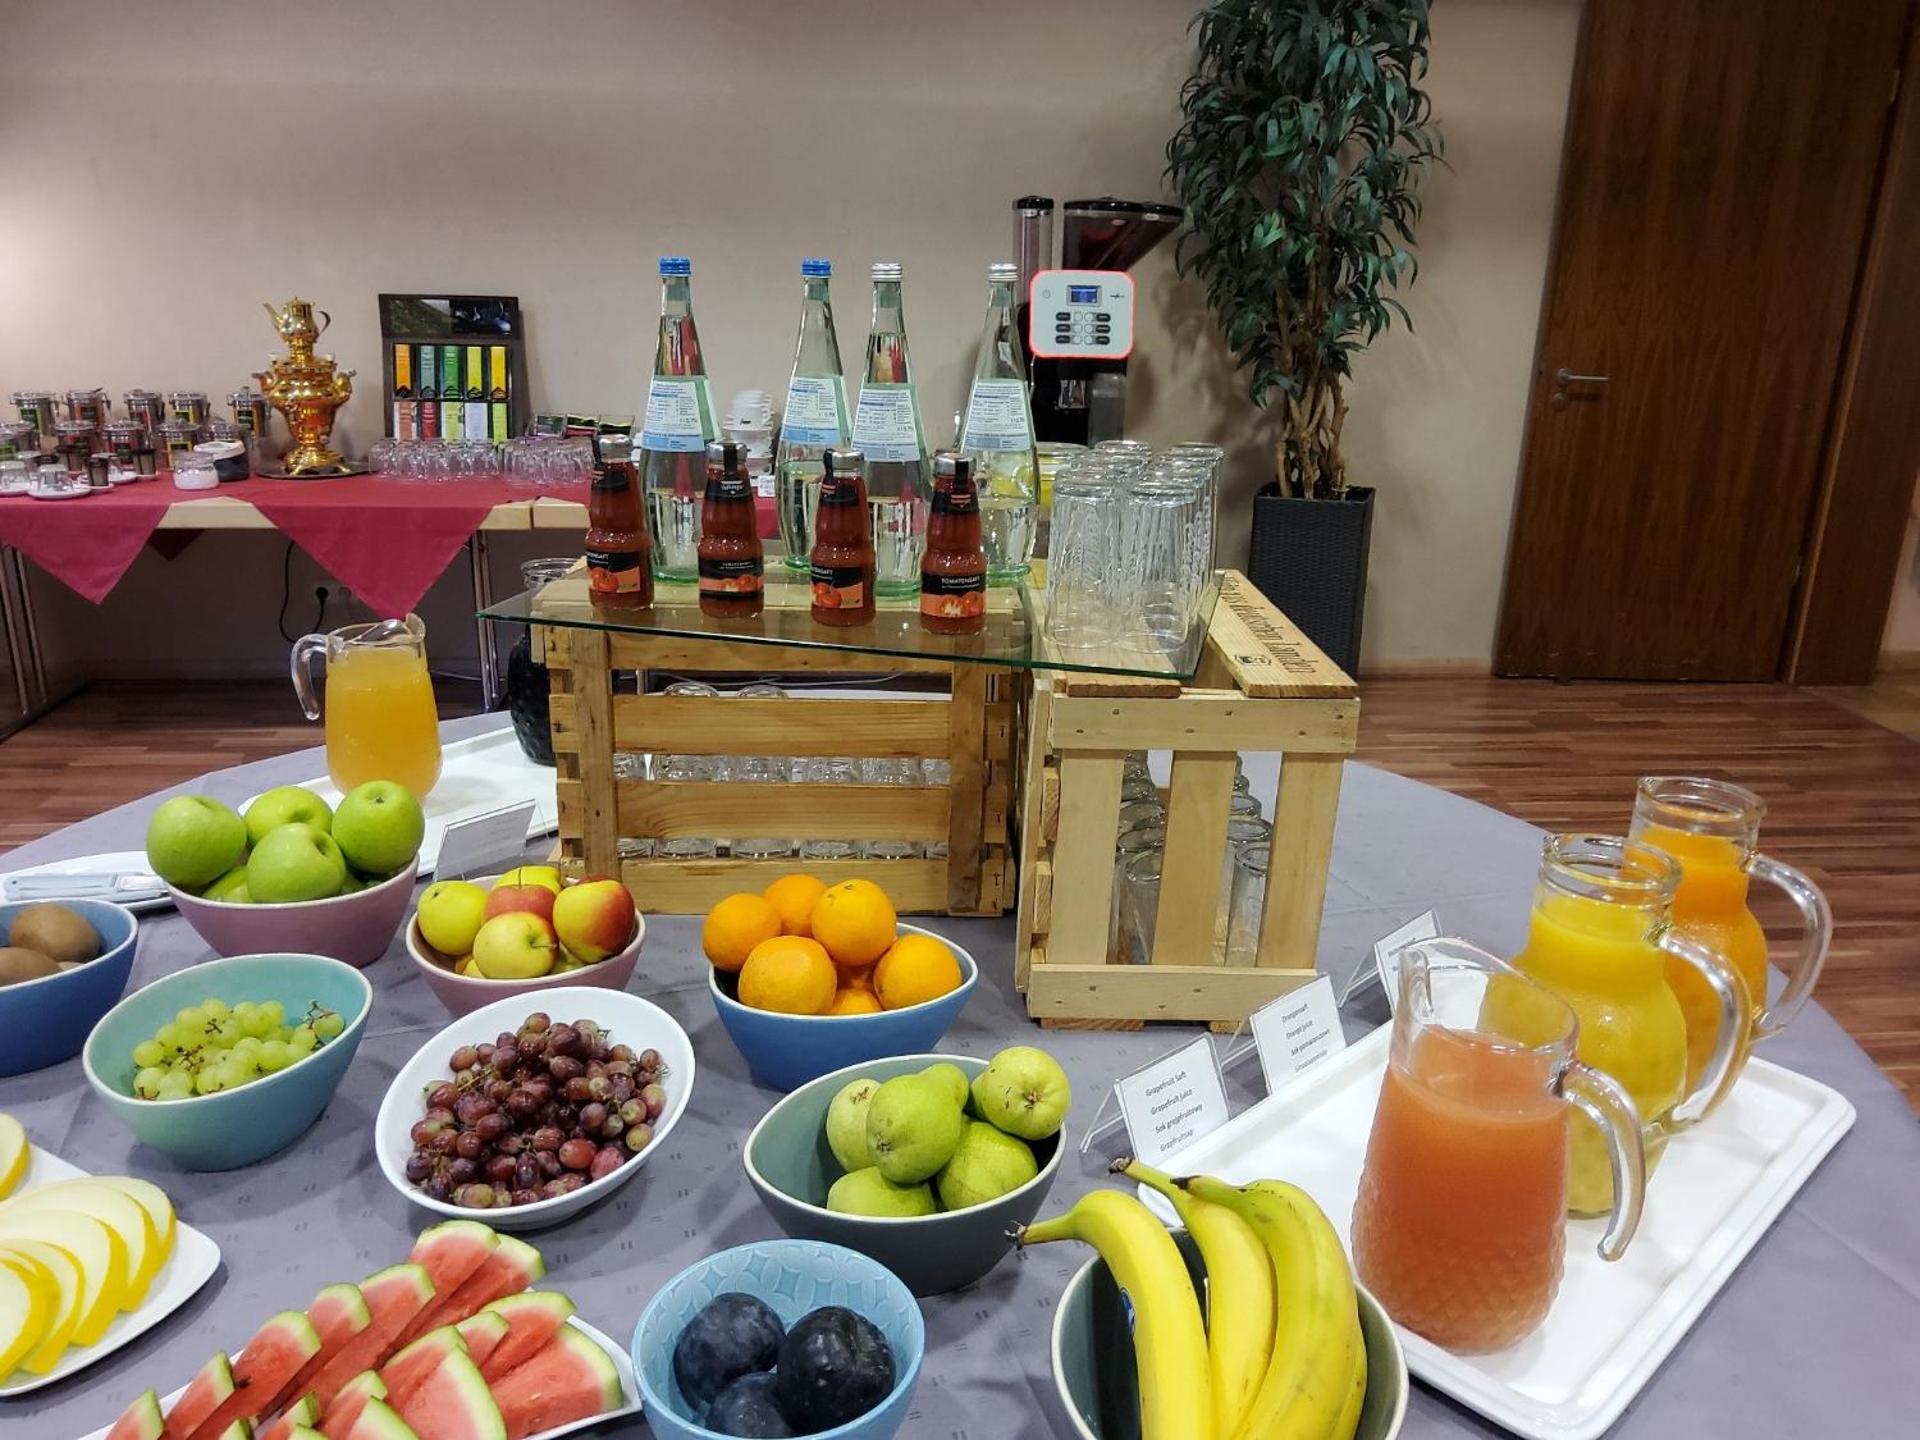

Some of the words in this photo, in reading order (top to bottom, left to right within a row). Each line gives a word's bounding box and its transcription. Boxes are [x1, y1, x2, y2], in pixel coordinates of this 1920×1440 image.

[941, 576, 980, 585] TOMATENSAFT
[1145, 1077, 1175, 1097] Grapefruit
[1150, 1095, 1180, 1115] Grapefruit
[1155, 1121, 1167, 1134] Sok
